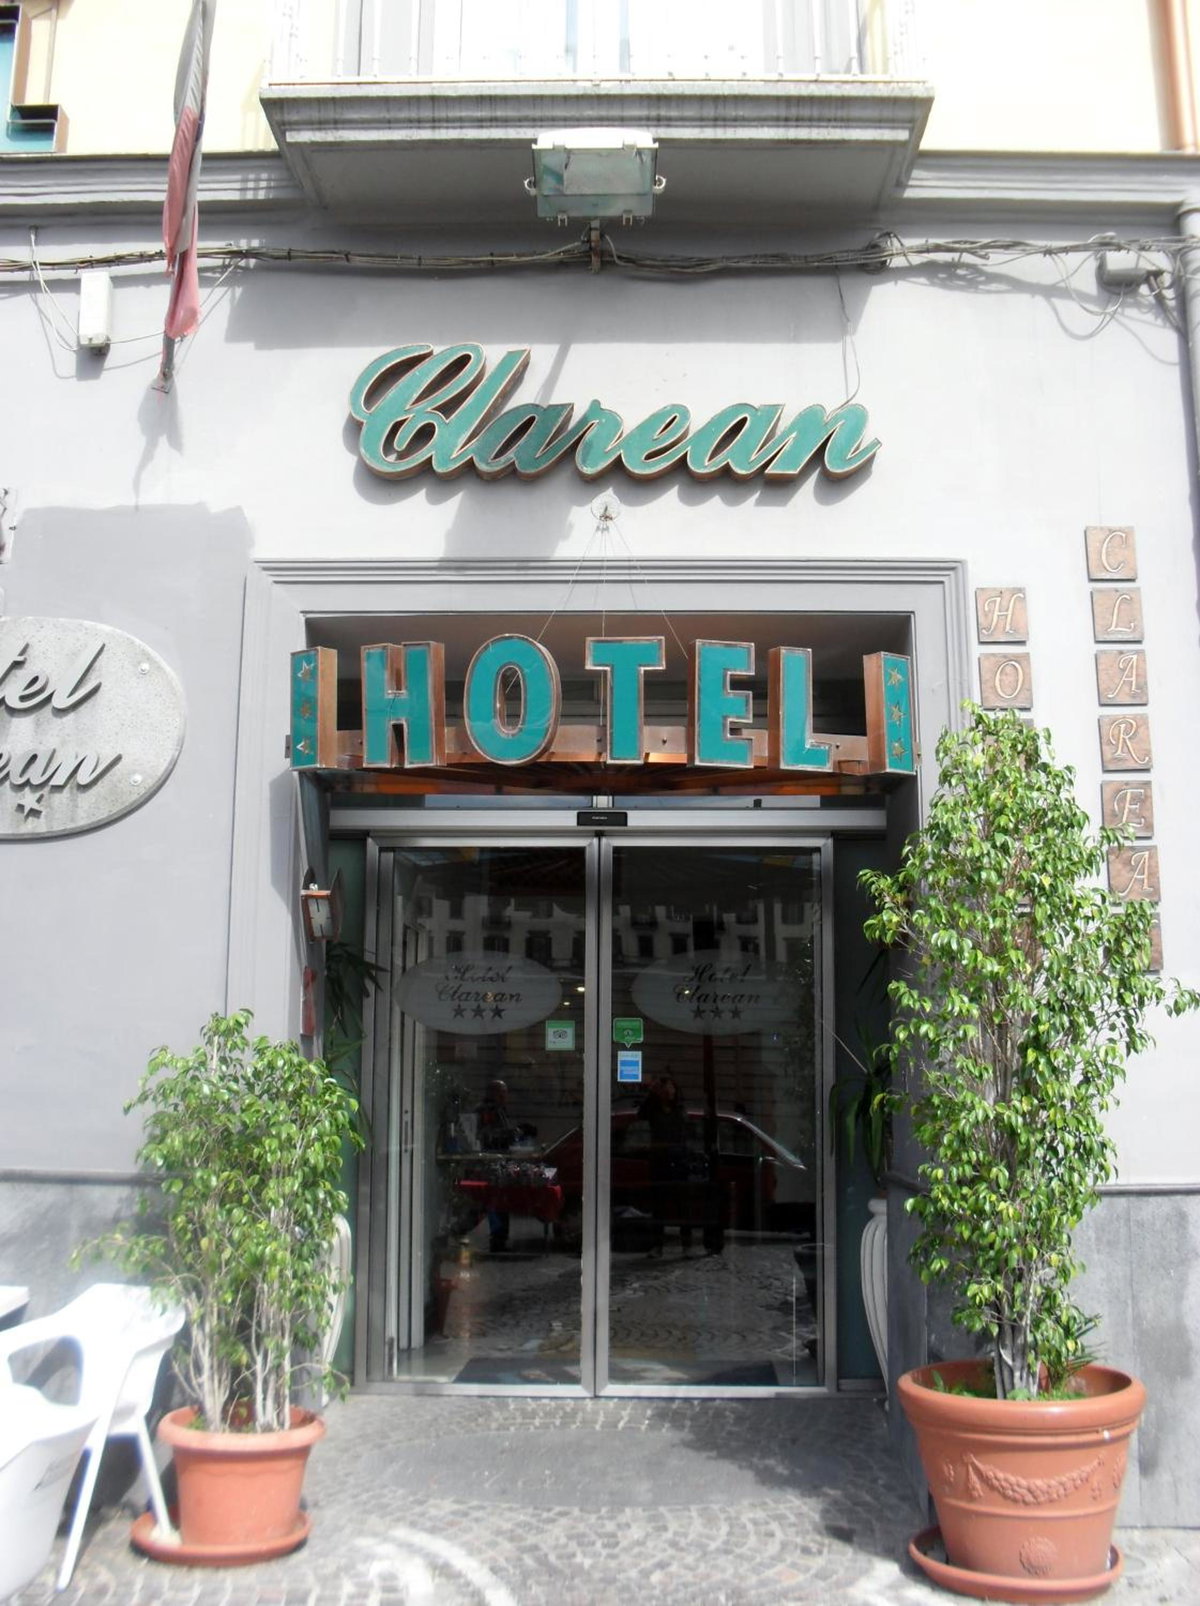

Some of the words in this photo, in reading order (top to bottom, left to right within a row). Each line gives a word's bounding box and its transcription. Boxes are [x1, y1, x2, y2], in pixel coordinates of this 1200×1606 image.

[350, 342, 884, 480] Clarean
[361, 633, 837, 770] HOTEL
[1100, 530, 1160, 972] CLAREA
